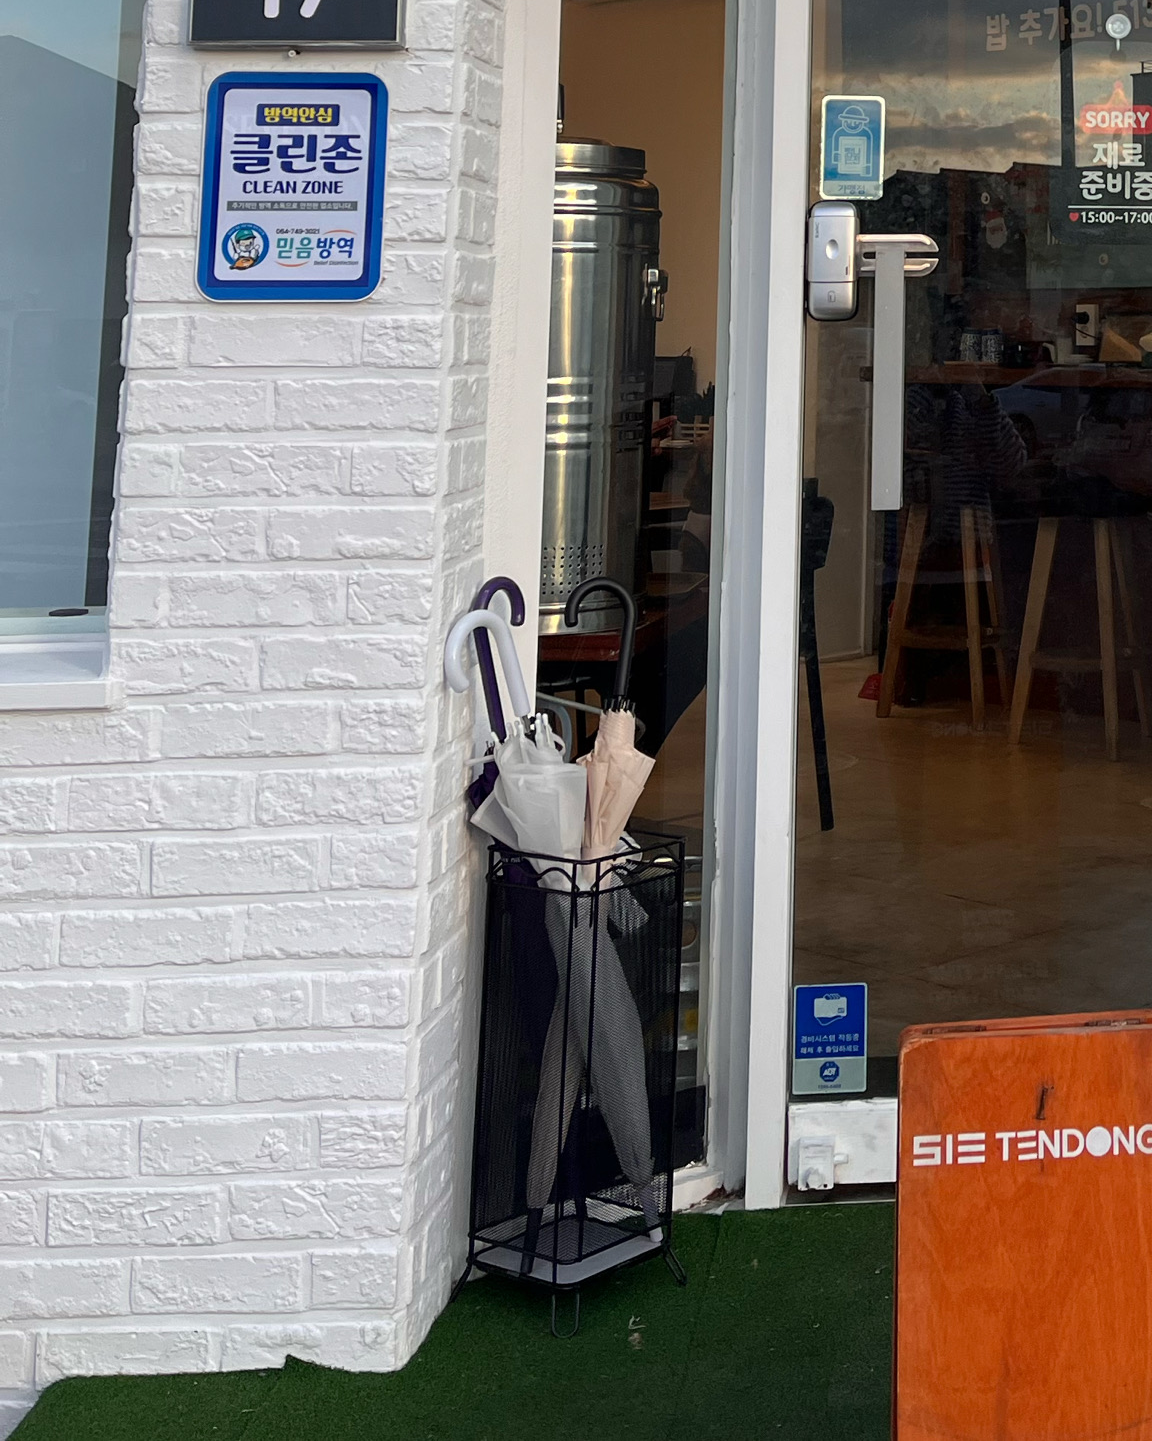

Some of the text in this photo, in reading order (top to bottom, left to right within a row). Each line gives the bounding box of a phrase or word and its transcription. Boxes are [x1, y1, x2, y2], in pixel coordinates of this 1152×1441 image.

[985, 14, 1009, 52] 밥
[1019, 2, 1103, 45] 추가요!
[264, 107, 332, 123] 방역안심
[1085, 111, 1150, 128] SORRY
[230, 133, 363, 174] 클린존
[1093, 141, 1145, 169] 재료
[242, 181, 343, 194] CLEAN ZONE
[276, 237, 354, 259] 믿음방역
